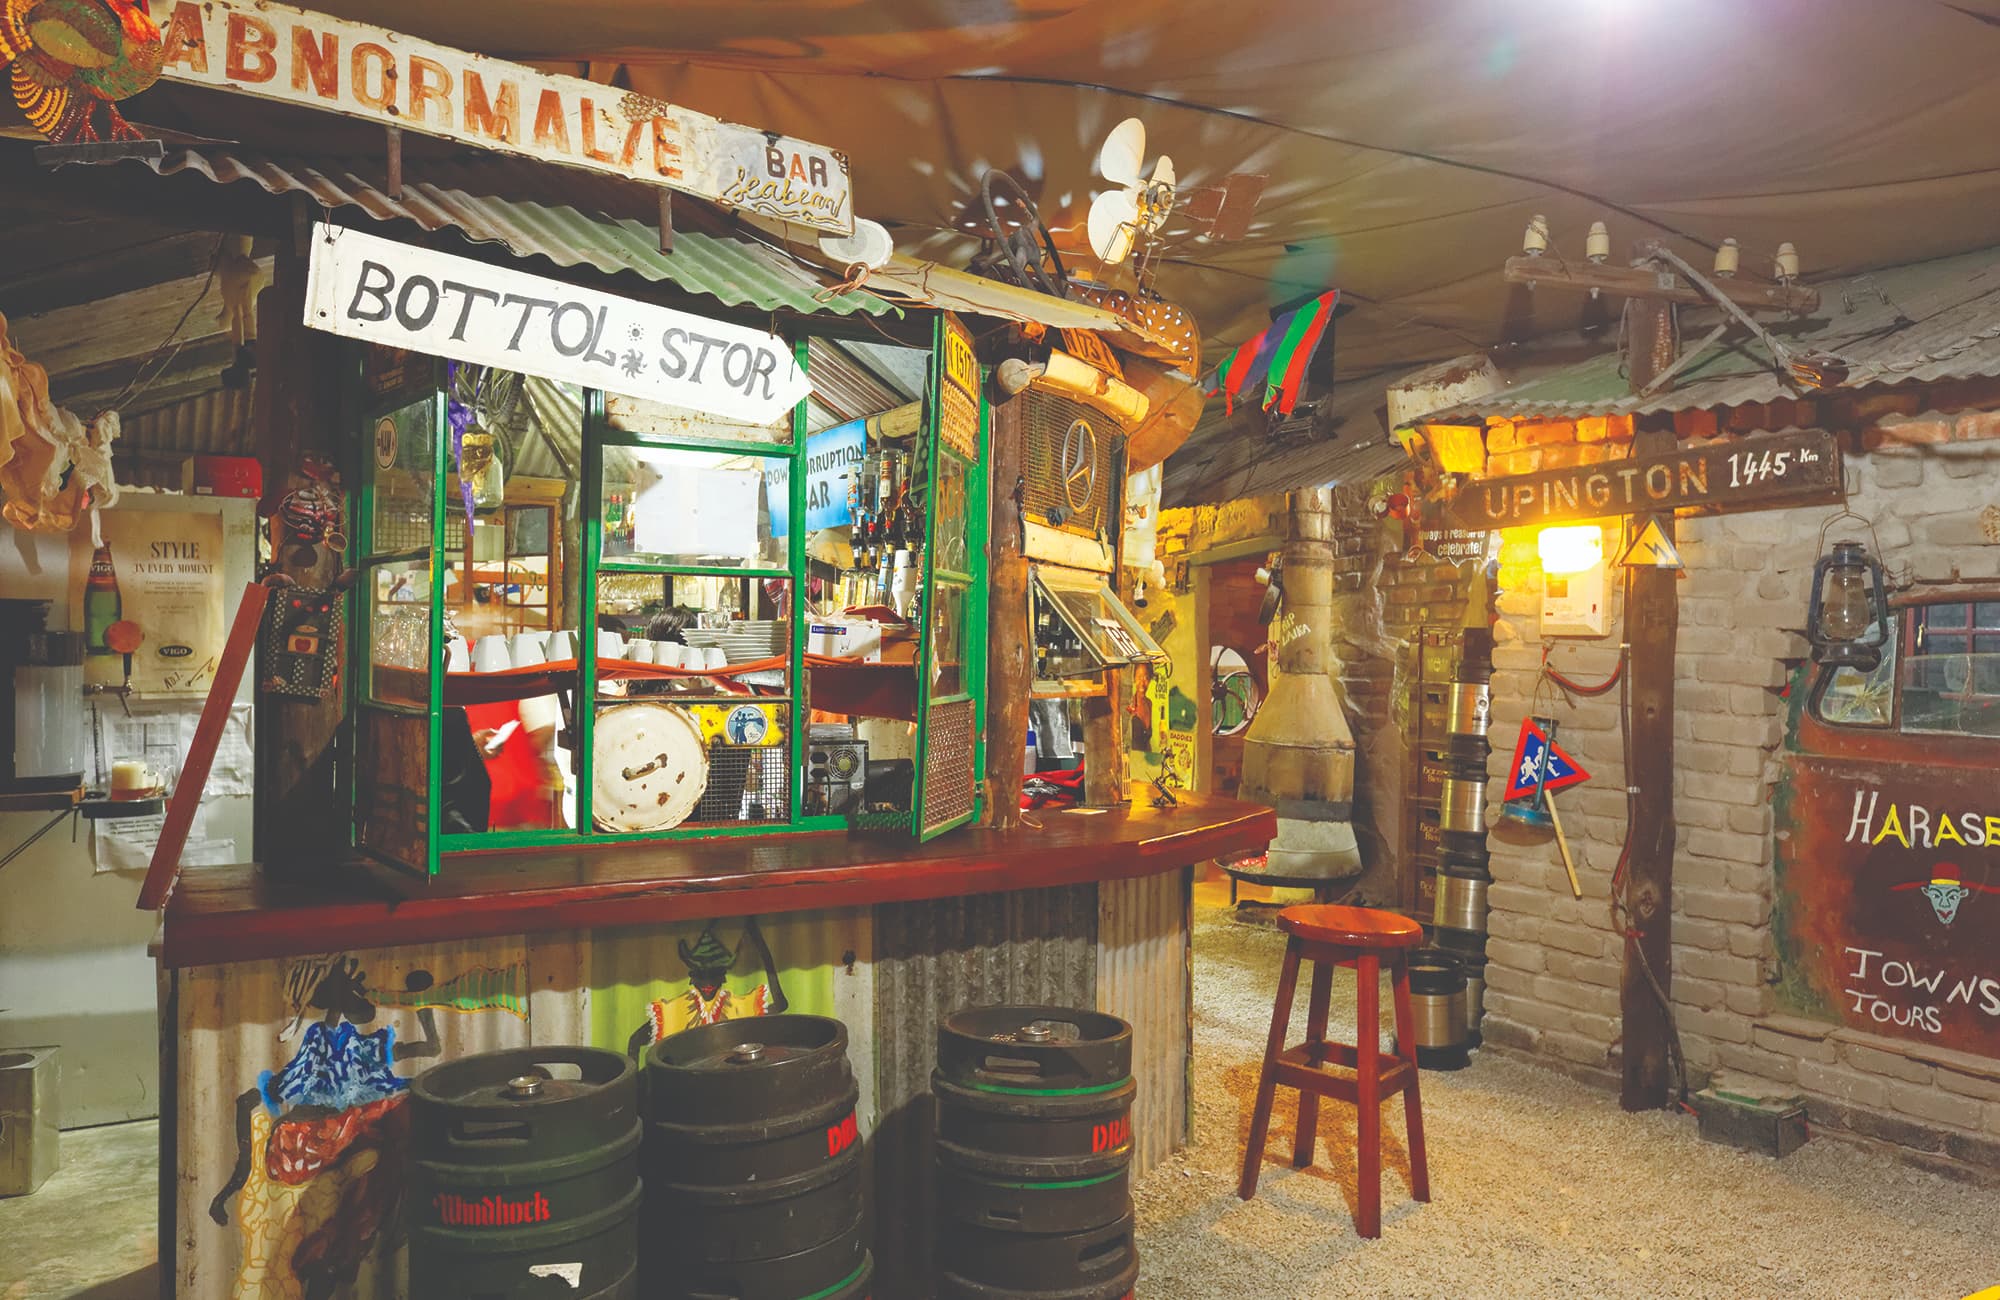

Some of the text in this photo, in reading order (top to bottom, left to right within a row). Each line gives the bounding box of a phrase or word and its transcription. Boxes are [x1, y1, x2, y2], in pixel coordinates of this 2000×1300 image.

[766, 146, 828, 188] BAR
[347, 260, 777, 401] BOTTOL STOR
[806, 481, 831, 511] AR
[1485, 447, 1820, 519] UPINGTON 1445 Km
[151, 541, 200, 560] STYLE
[1437, 541, 1484, 556] celebrate!
[135, 563, 213, 574] IN EVERY MOMENT
[162, 648, 188, 656] VIGO
[1845, 790, 2000, 849] HARASE
[1845, 989, 1942, 1033] TOURS
